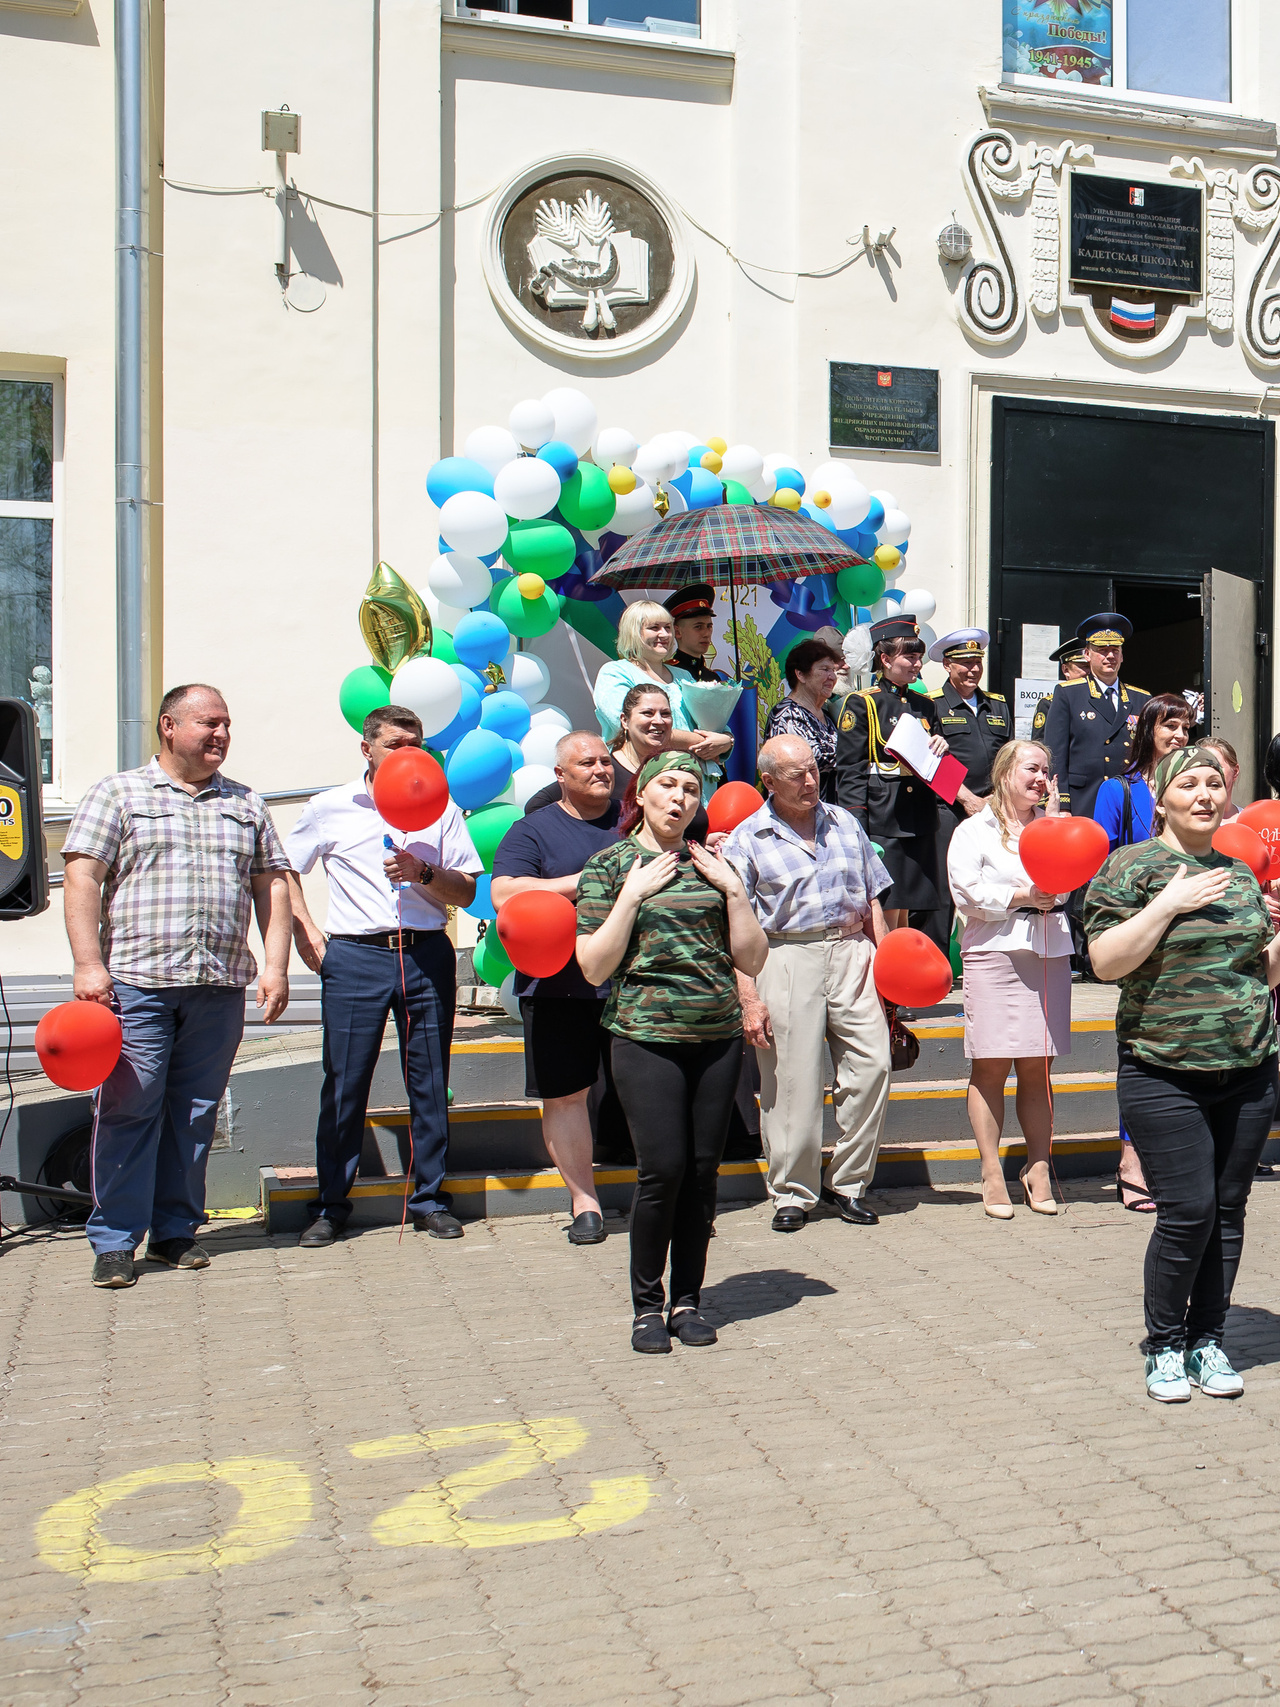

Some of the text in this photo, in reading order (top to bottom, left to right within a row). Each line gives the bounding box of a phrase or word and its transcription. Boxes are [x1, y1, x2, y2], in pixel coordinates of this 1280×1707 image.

[1047, 22, 1107, 44] Победы!
[1029, 49, 1092, 69] 1941-1945
[1073, 212, 1200, 233] АДМИНИСТРАЦИИ ГОРОДА ХАБАРОВСКА
[1093, 208, 1181, 224] УПРАВЛЕНИЕ ОБРАЗОВАНИЯ
[1094, 228, 1143, 239] Муниципальное
[1086, 234, 1187, 251] общеобразовательное учреждение
[1078, 248, 1195, 269] КАДЕТСКАЯ ШКОЛА №1
[1115, 268, 1139, 276] Ушакова
[1140, 271, 1158, 279] города
[1159, 272, 1191, 282] Хабаровска
[854, 427, 914, 436] ОБРАЗОВАТЕЛЬНЫЕ
[1020, 691, 1044, 700] ВХОД
